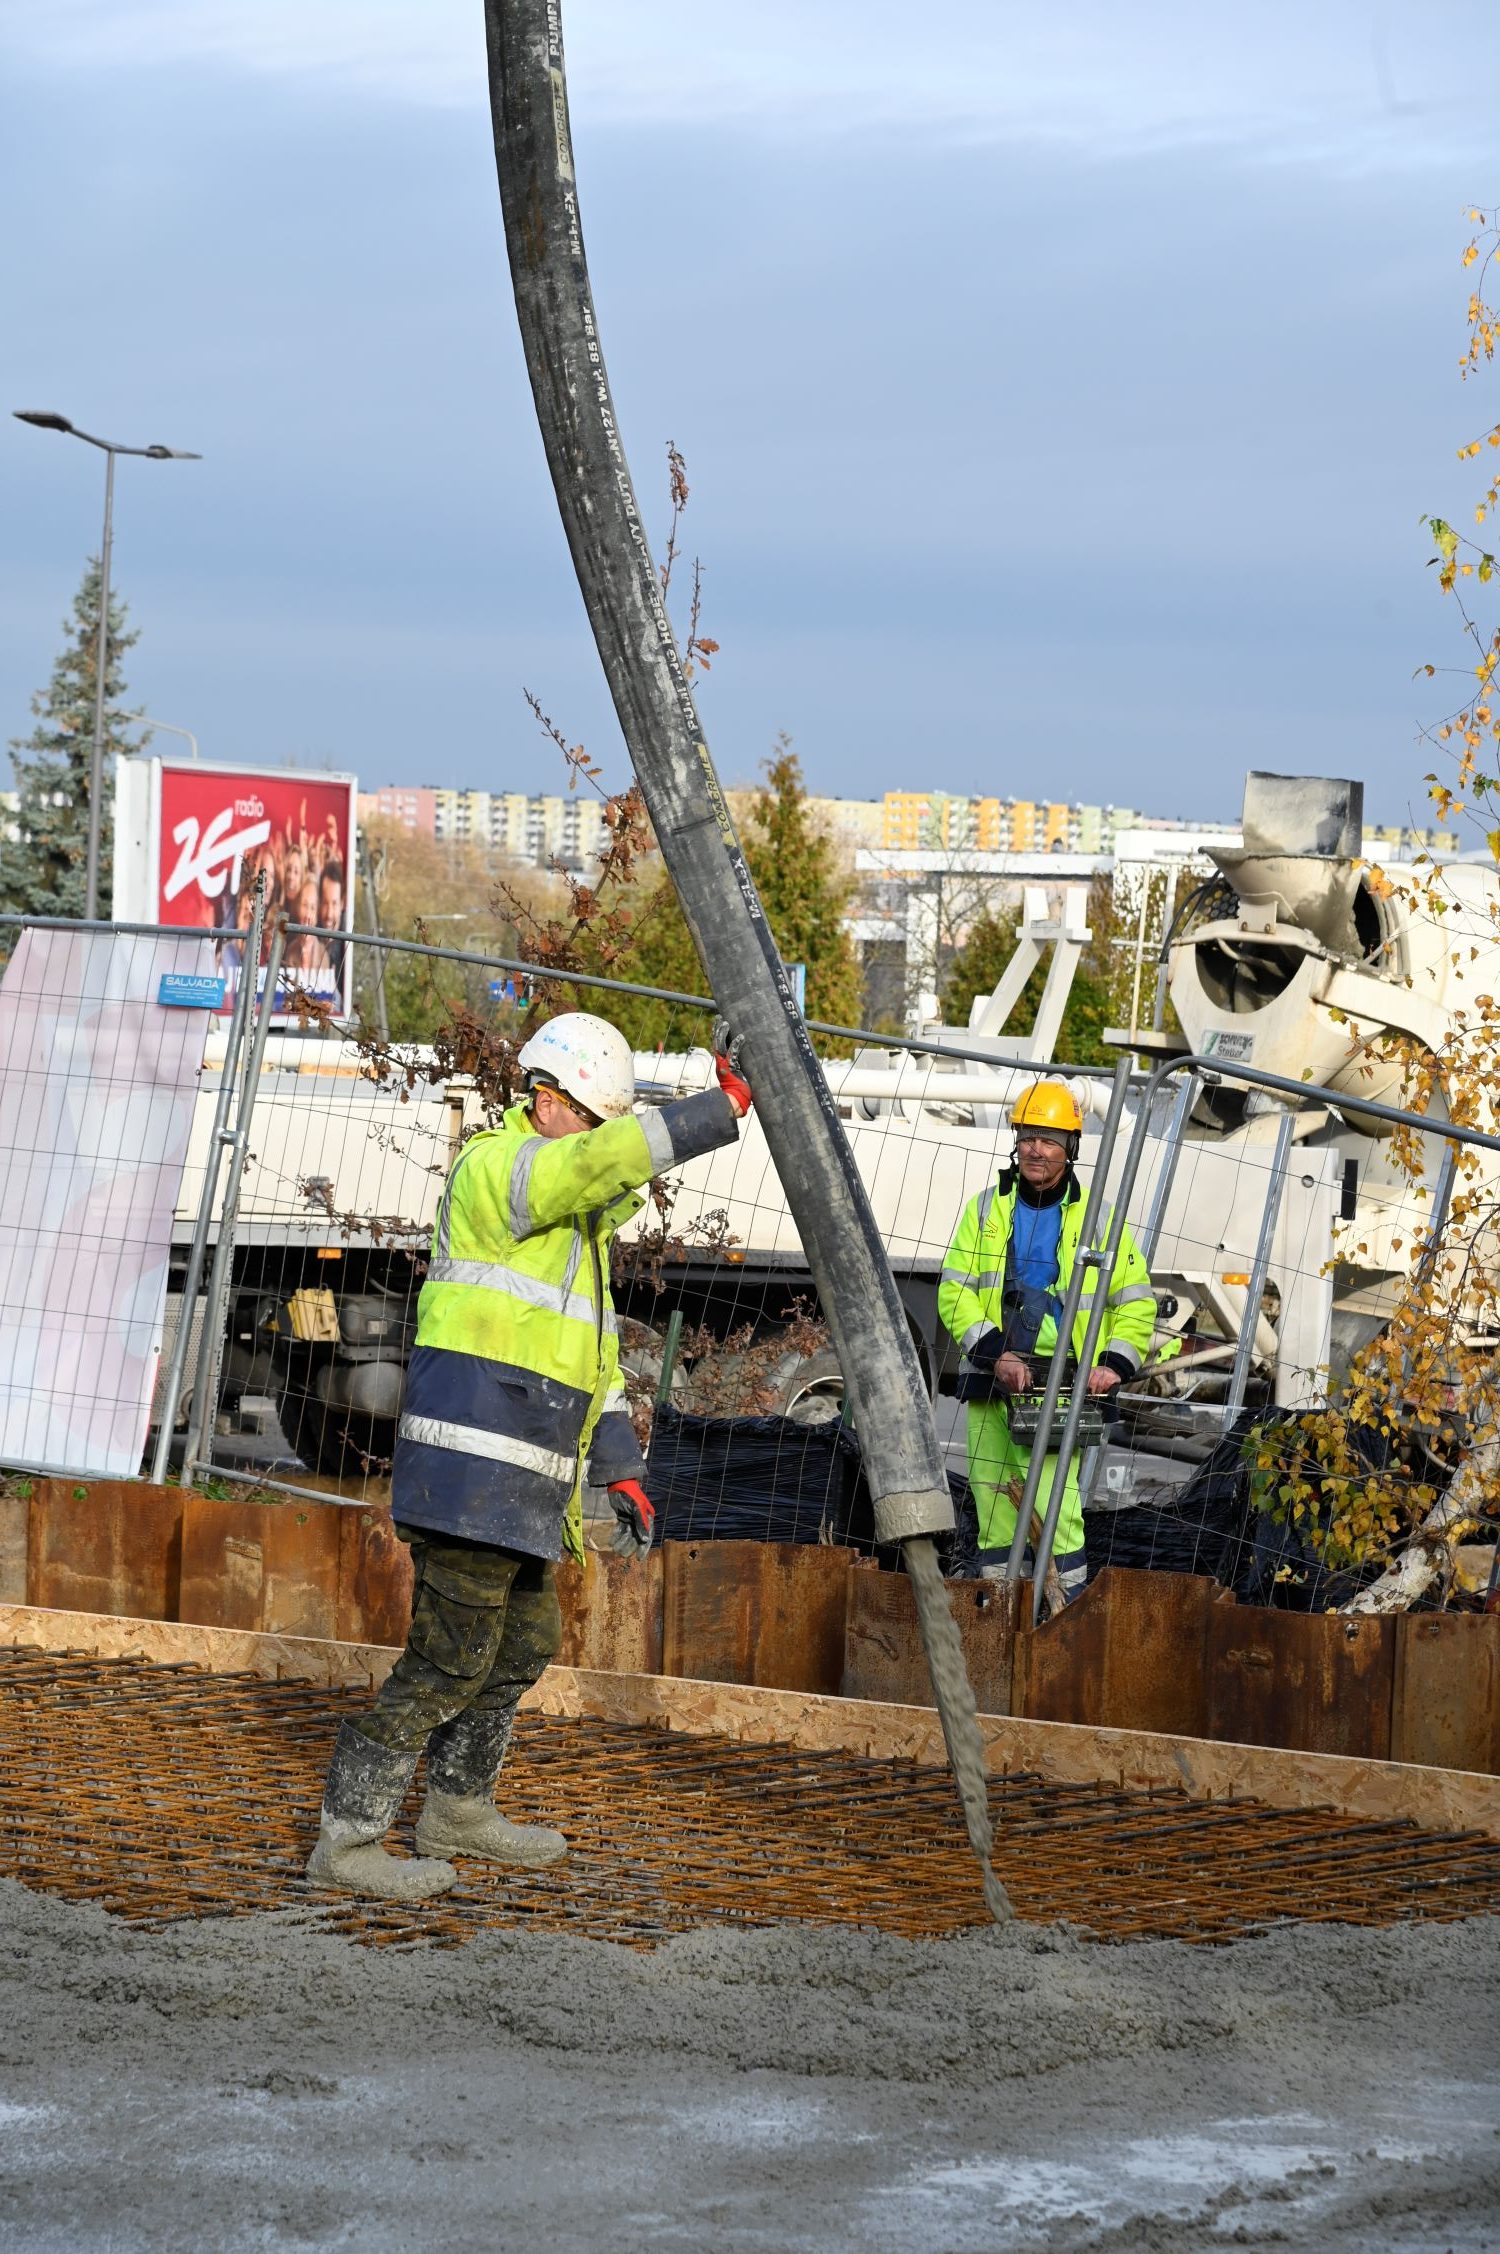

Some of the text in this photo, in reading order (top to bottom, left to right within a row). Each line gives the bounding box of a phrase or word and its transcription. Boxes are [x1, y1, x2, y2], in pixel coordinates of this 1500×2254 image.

[553, 81, 569, 164] CONCRETE
[581, 307, 595, 336] Bar
[587, 342, 600, 363] 85
[615, 469, 636, 517] DUTY
[648, 594, 672, 645] HOSE
[235, 795, 264, 817] radio
[699, 754, 731, 833] CONCRETE
[164, 808, 271, 902] ZET
